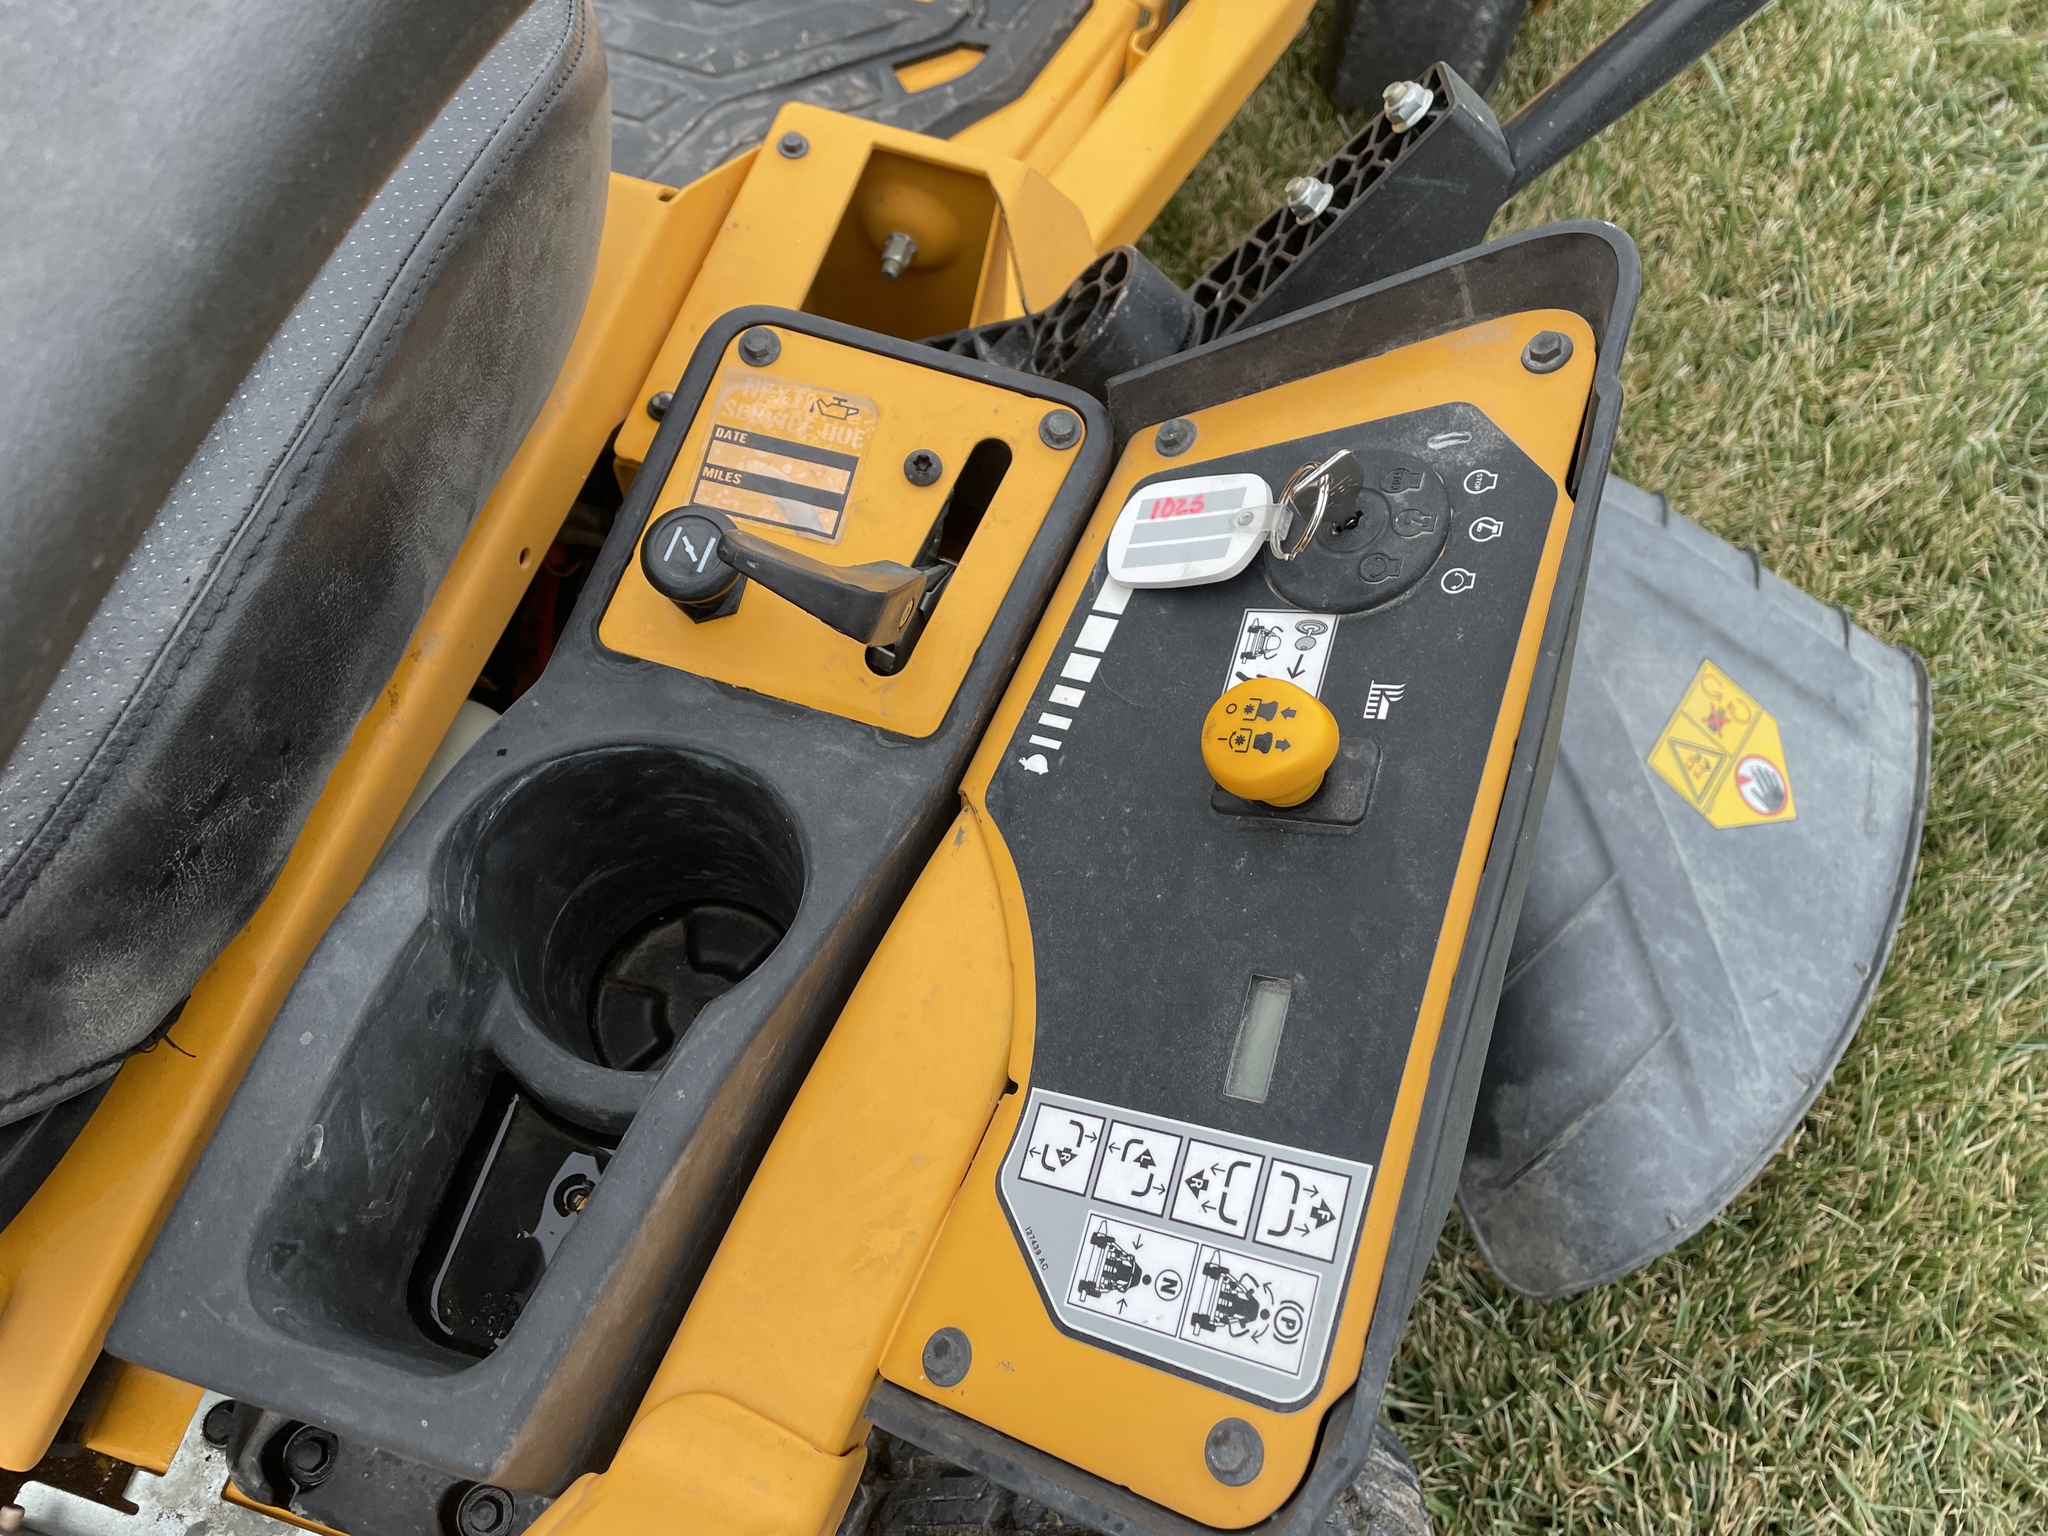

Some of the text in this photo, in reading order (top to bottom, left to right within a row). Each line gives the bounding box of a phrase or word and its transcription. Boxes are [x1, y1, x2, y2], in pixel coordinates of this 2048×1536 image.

[714, 426, 749, 444] DATE
[701, 466, 743, 485] MILES
[1474, 472, 1484, 491] STOP
[1060, 1151, 1072, 1162] R
[1140, 1154, 1152, 1163] L
[1189, 1176, 1204, 1190] R
[1316, 1208, 1331, 1222] F
[1025, 1226, 1049, 1271] 127439 AC
[1160, 1276, 1178, 1296] N
[1280, 1316, 1297, 1331] P
